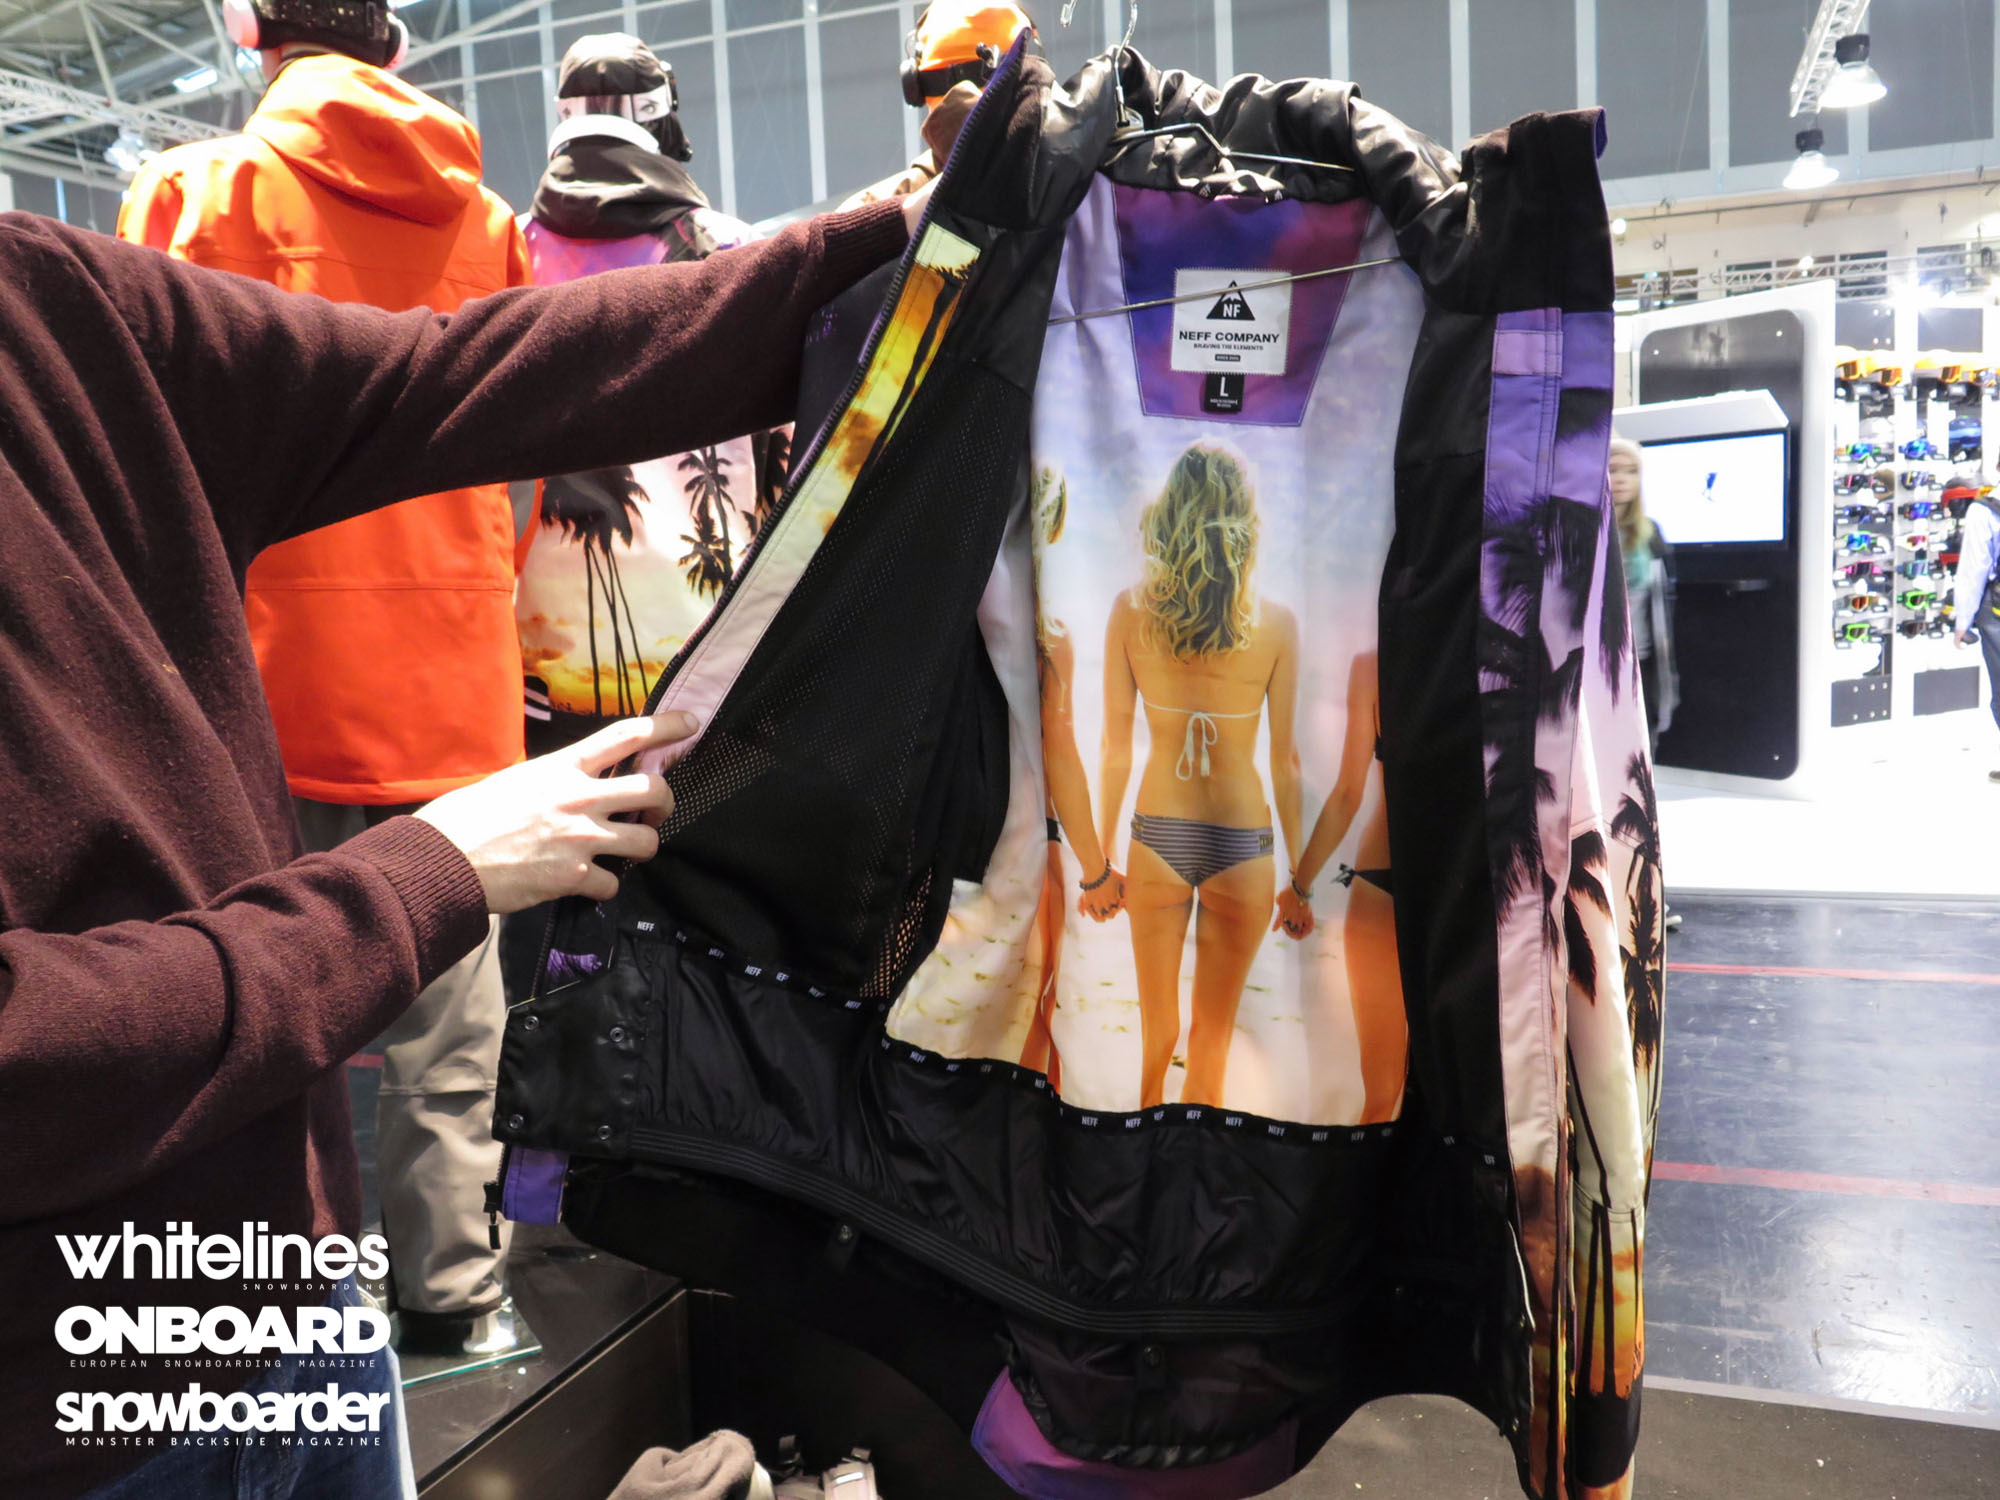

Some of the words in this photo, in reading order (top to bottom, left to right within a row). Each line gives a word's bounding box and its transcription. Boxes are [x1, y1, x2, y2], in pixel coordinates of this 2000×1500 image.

[1222, 303, 1241, 318] NF
[1179, 330, 1212, 341] NEFF
[1215, 332, 1280, 343] COMPANY
[1219, 376, 1229, 397] L
[637, 920, 655, 932] NEFF
[744, 965, 762, 977] NEFF
[1034, 1078, 1046, 1089] NEF
[1081, 1115, 1099, 1127] NEFF
[1125, 1117, 1142, 1129] NEFF
[1186, 1109, 1202, 1121] NEFF
[1225, 1115, 1243, 1128] NEFF
[1267, 1124, 1285, 1137] NEFF
